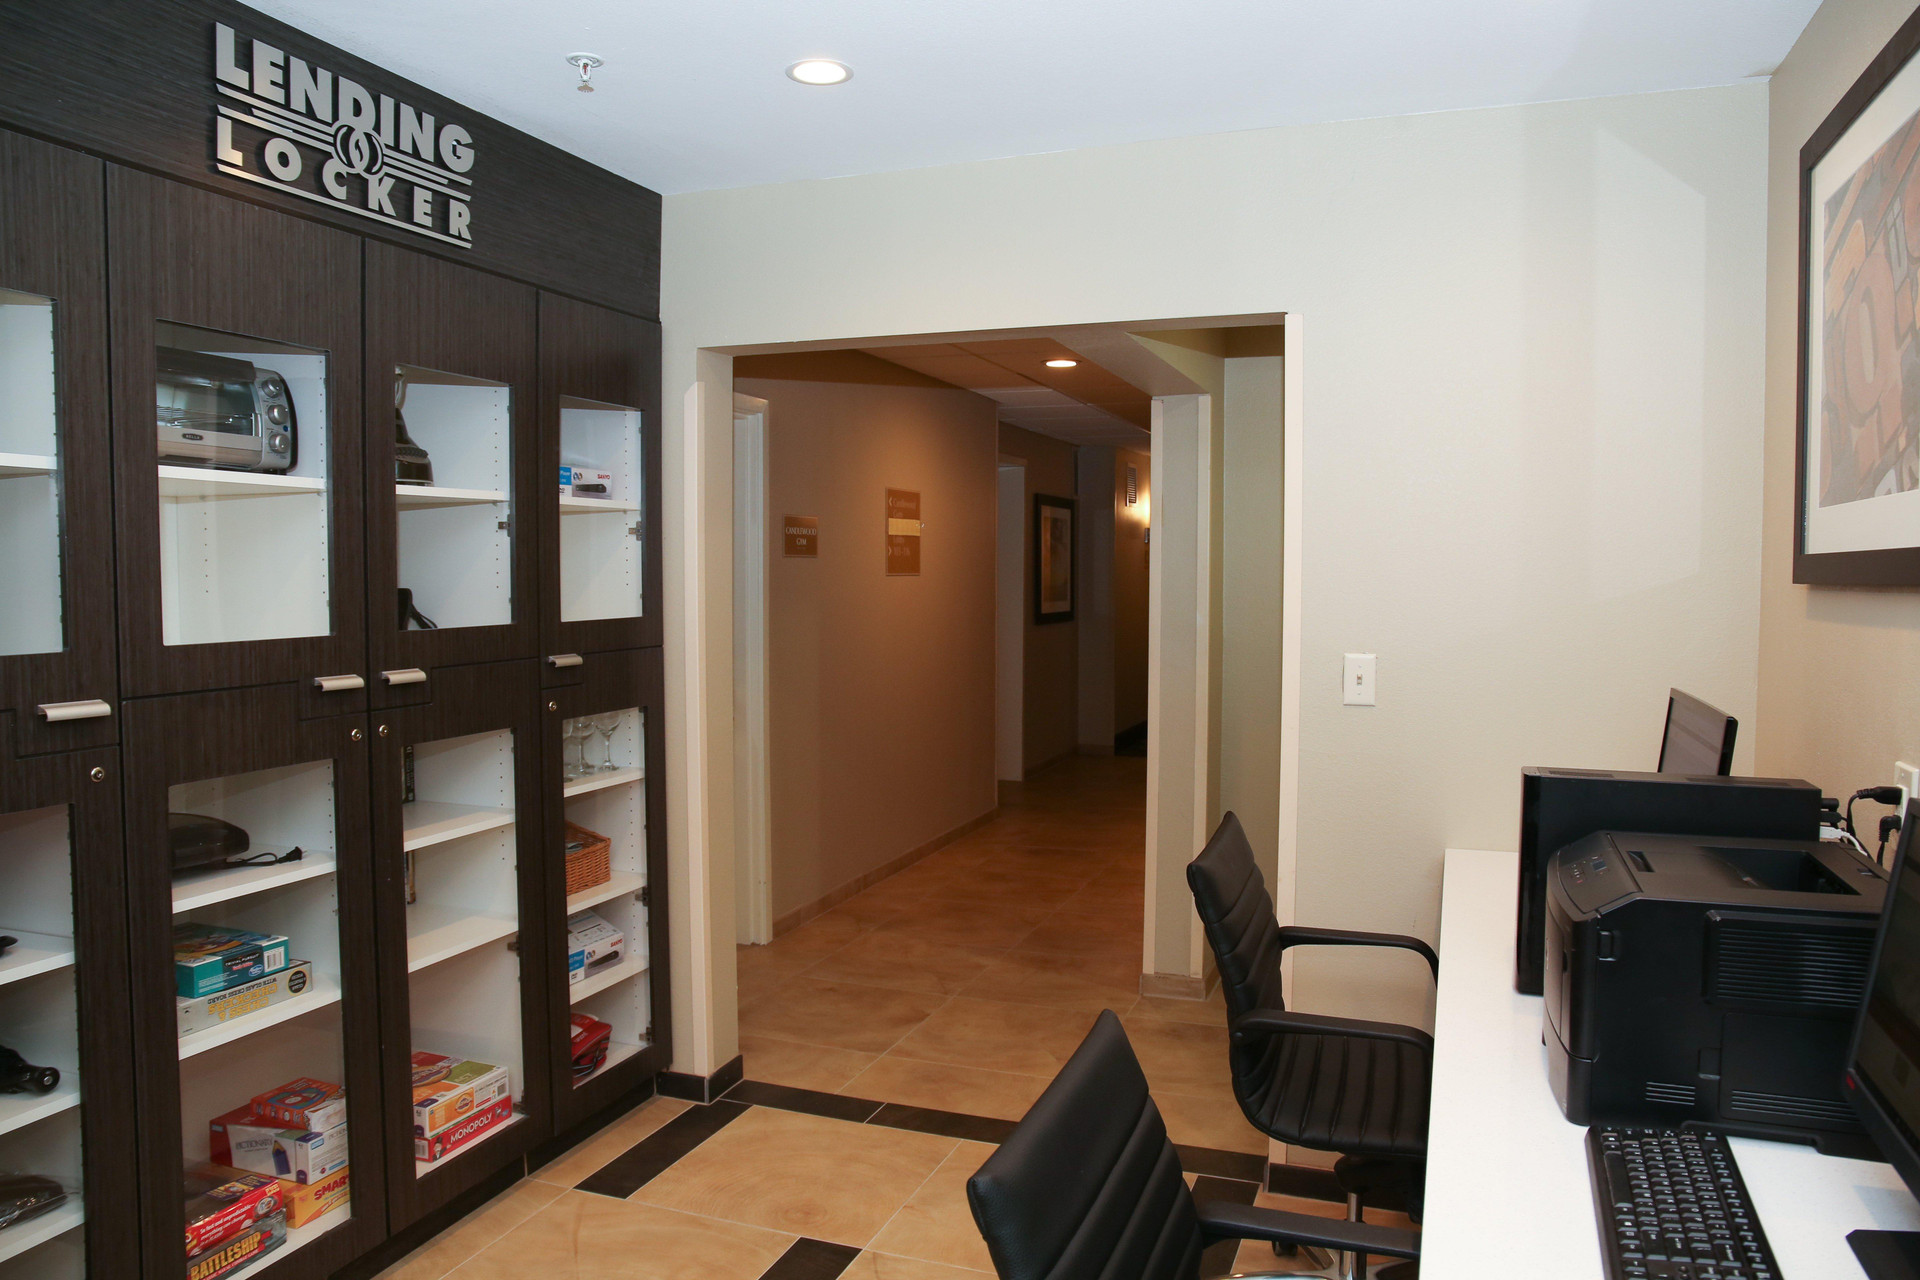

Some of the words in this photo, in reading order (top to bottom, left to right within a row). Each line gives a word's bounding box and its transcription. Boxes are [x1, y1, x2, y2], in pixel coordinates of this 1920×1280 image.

[215, 21, 475, 173] LENDING
[216, 115, 472, 241] LOCKER
[785, 526, 817, 536] CANDLEWOOD
[796, 537, 807, 546] GYM
[207, 983, 278, 1015] CHECKERS
[229, 997, 269, 1018] CHESS
[450, 1112, 493, 1143] MONOPOLY
[235, 1137, 274, 1150] PICTIONARY
[190, 1231, 261, 1280] BATTLESHIP
